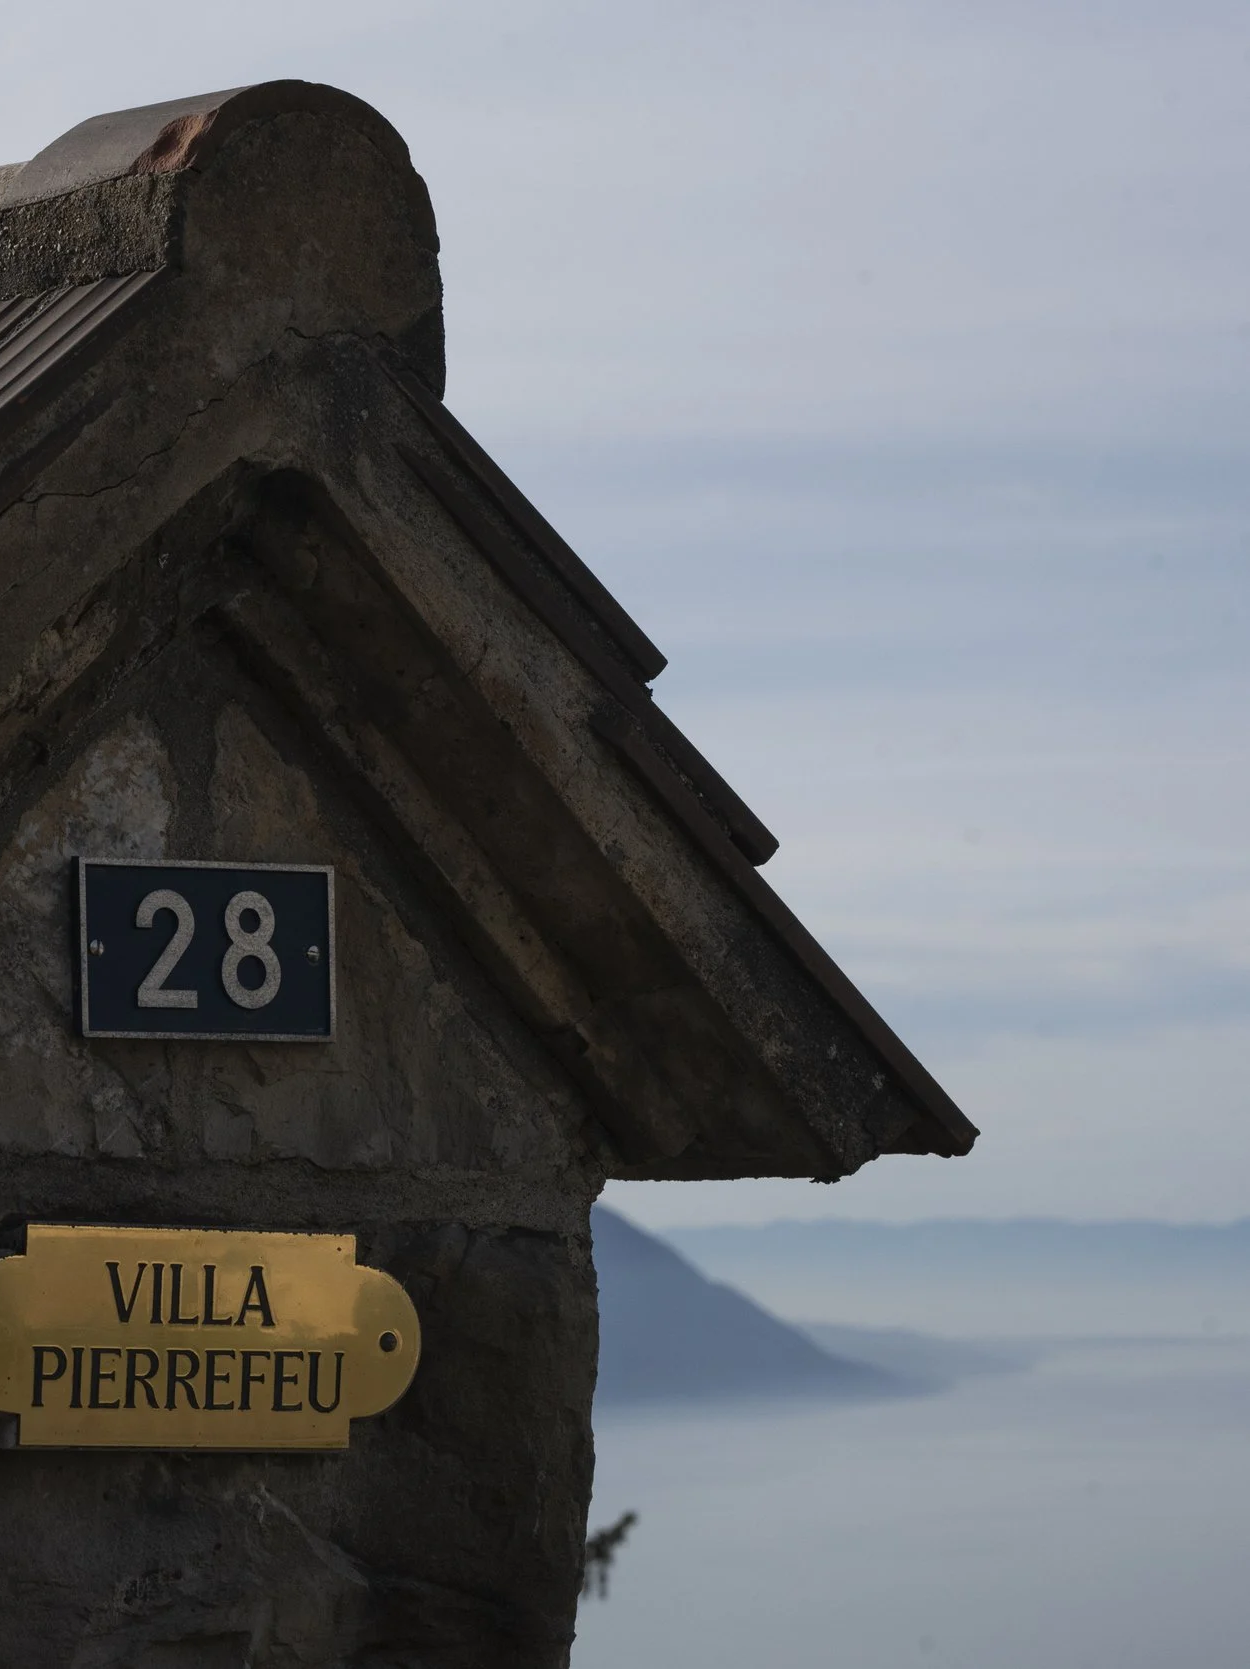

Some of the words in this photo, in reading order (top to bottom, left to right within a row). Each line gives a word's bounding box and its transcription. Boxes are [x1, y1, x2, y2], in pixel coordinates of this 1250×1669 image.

[136, 888, 281, 1009] 28
[105, 1261, 276, 1327] VILLA
[31, 1345, 346, 1413] PIERREFEU
